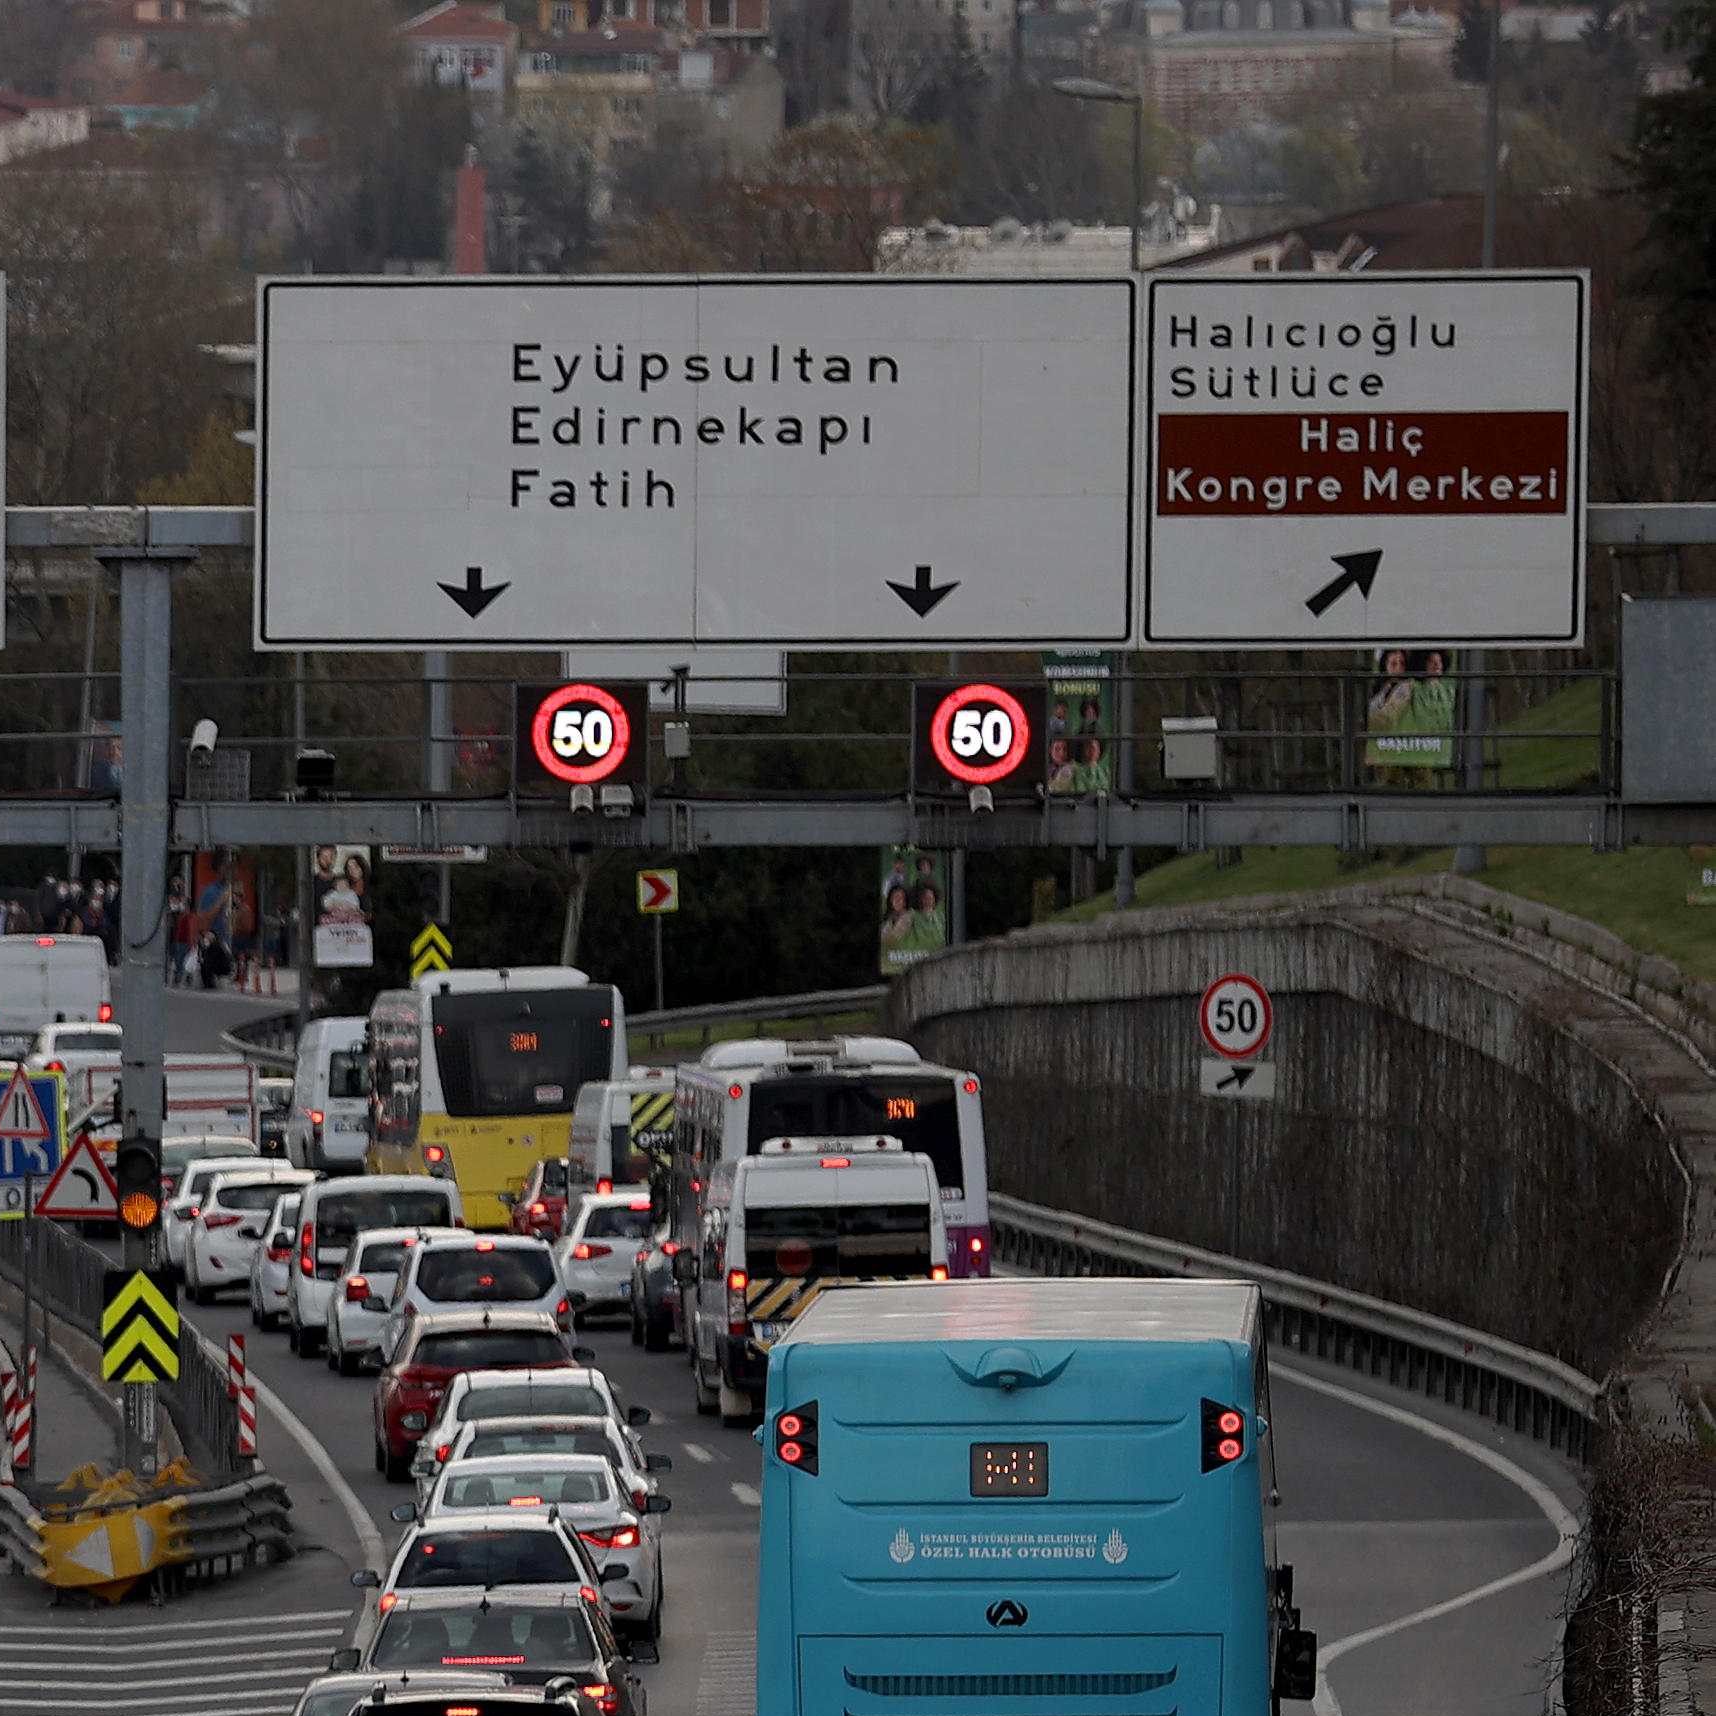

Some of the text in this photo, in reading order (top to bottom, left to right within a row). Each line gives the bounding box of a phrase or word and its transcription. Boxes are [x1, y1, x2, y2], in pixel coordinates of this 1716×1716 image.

[1170, 314, 1456, 357] Halıcıoğlu
[512, 343, 899, 393] Eyüpsultan
[1170, 366, 1385, 399] Sütlüce
[511, 406, 872, 455] Edirnekapı
[1300, 417, 1424, 456] Haliç
[511, 468, 675, 508] Fatih
[1166, 466, 1557, 510] Kongre Merkezi
[552, 709, 614, 758] 50
[951, 709, 1013, 757] 50
[1215, 998, 1258, 1033] 50
[921, 1544, 1096, 1559] ÖZEL HALK OTOBÜSÜ
